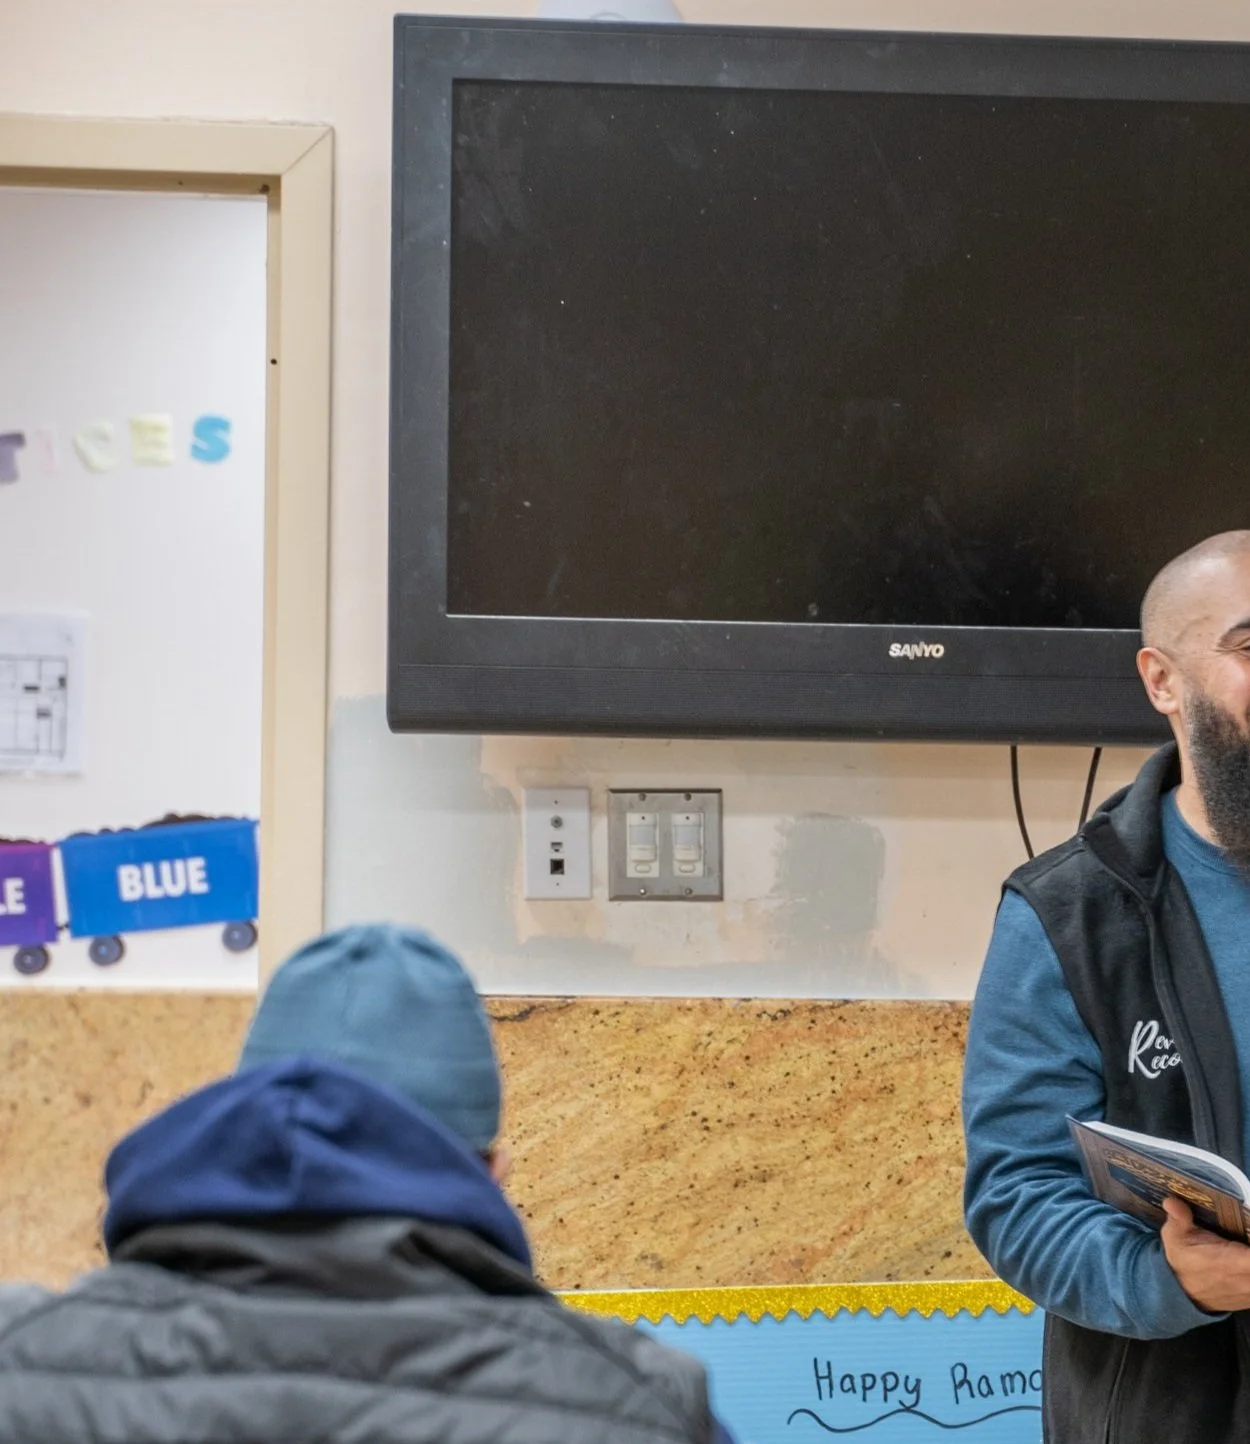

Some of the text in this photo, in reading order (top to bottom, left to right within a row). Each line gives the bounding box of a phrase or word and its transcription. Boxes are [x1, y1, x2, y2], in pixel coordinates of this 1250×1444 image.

[888, 641, 945, 660] SANYO
[116, 856, 210, 902] BLUE
[813, 1357, 921, 1410] Happy
